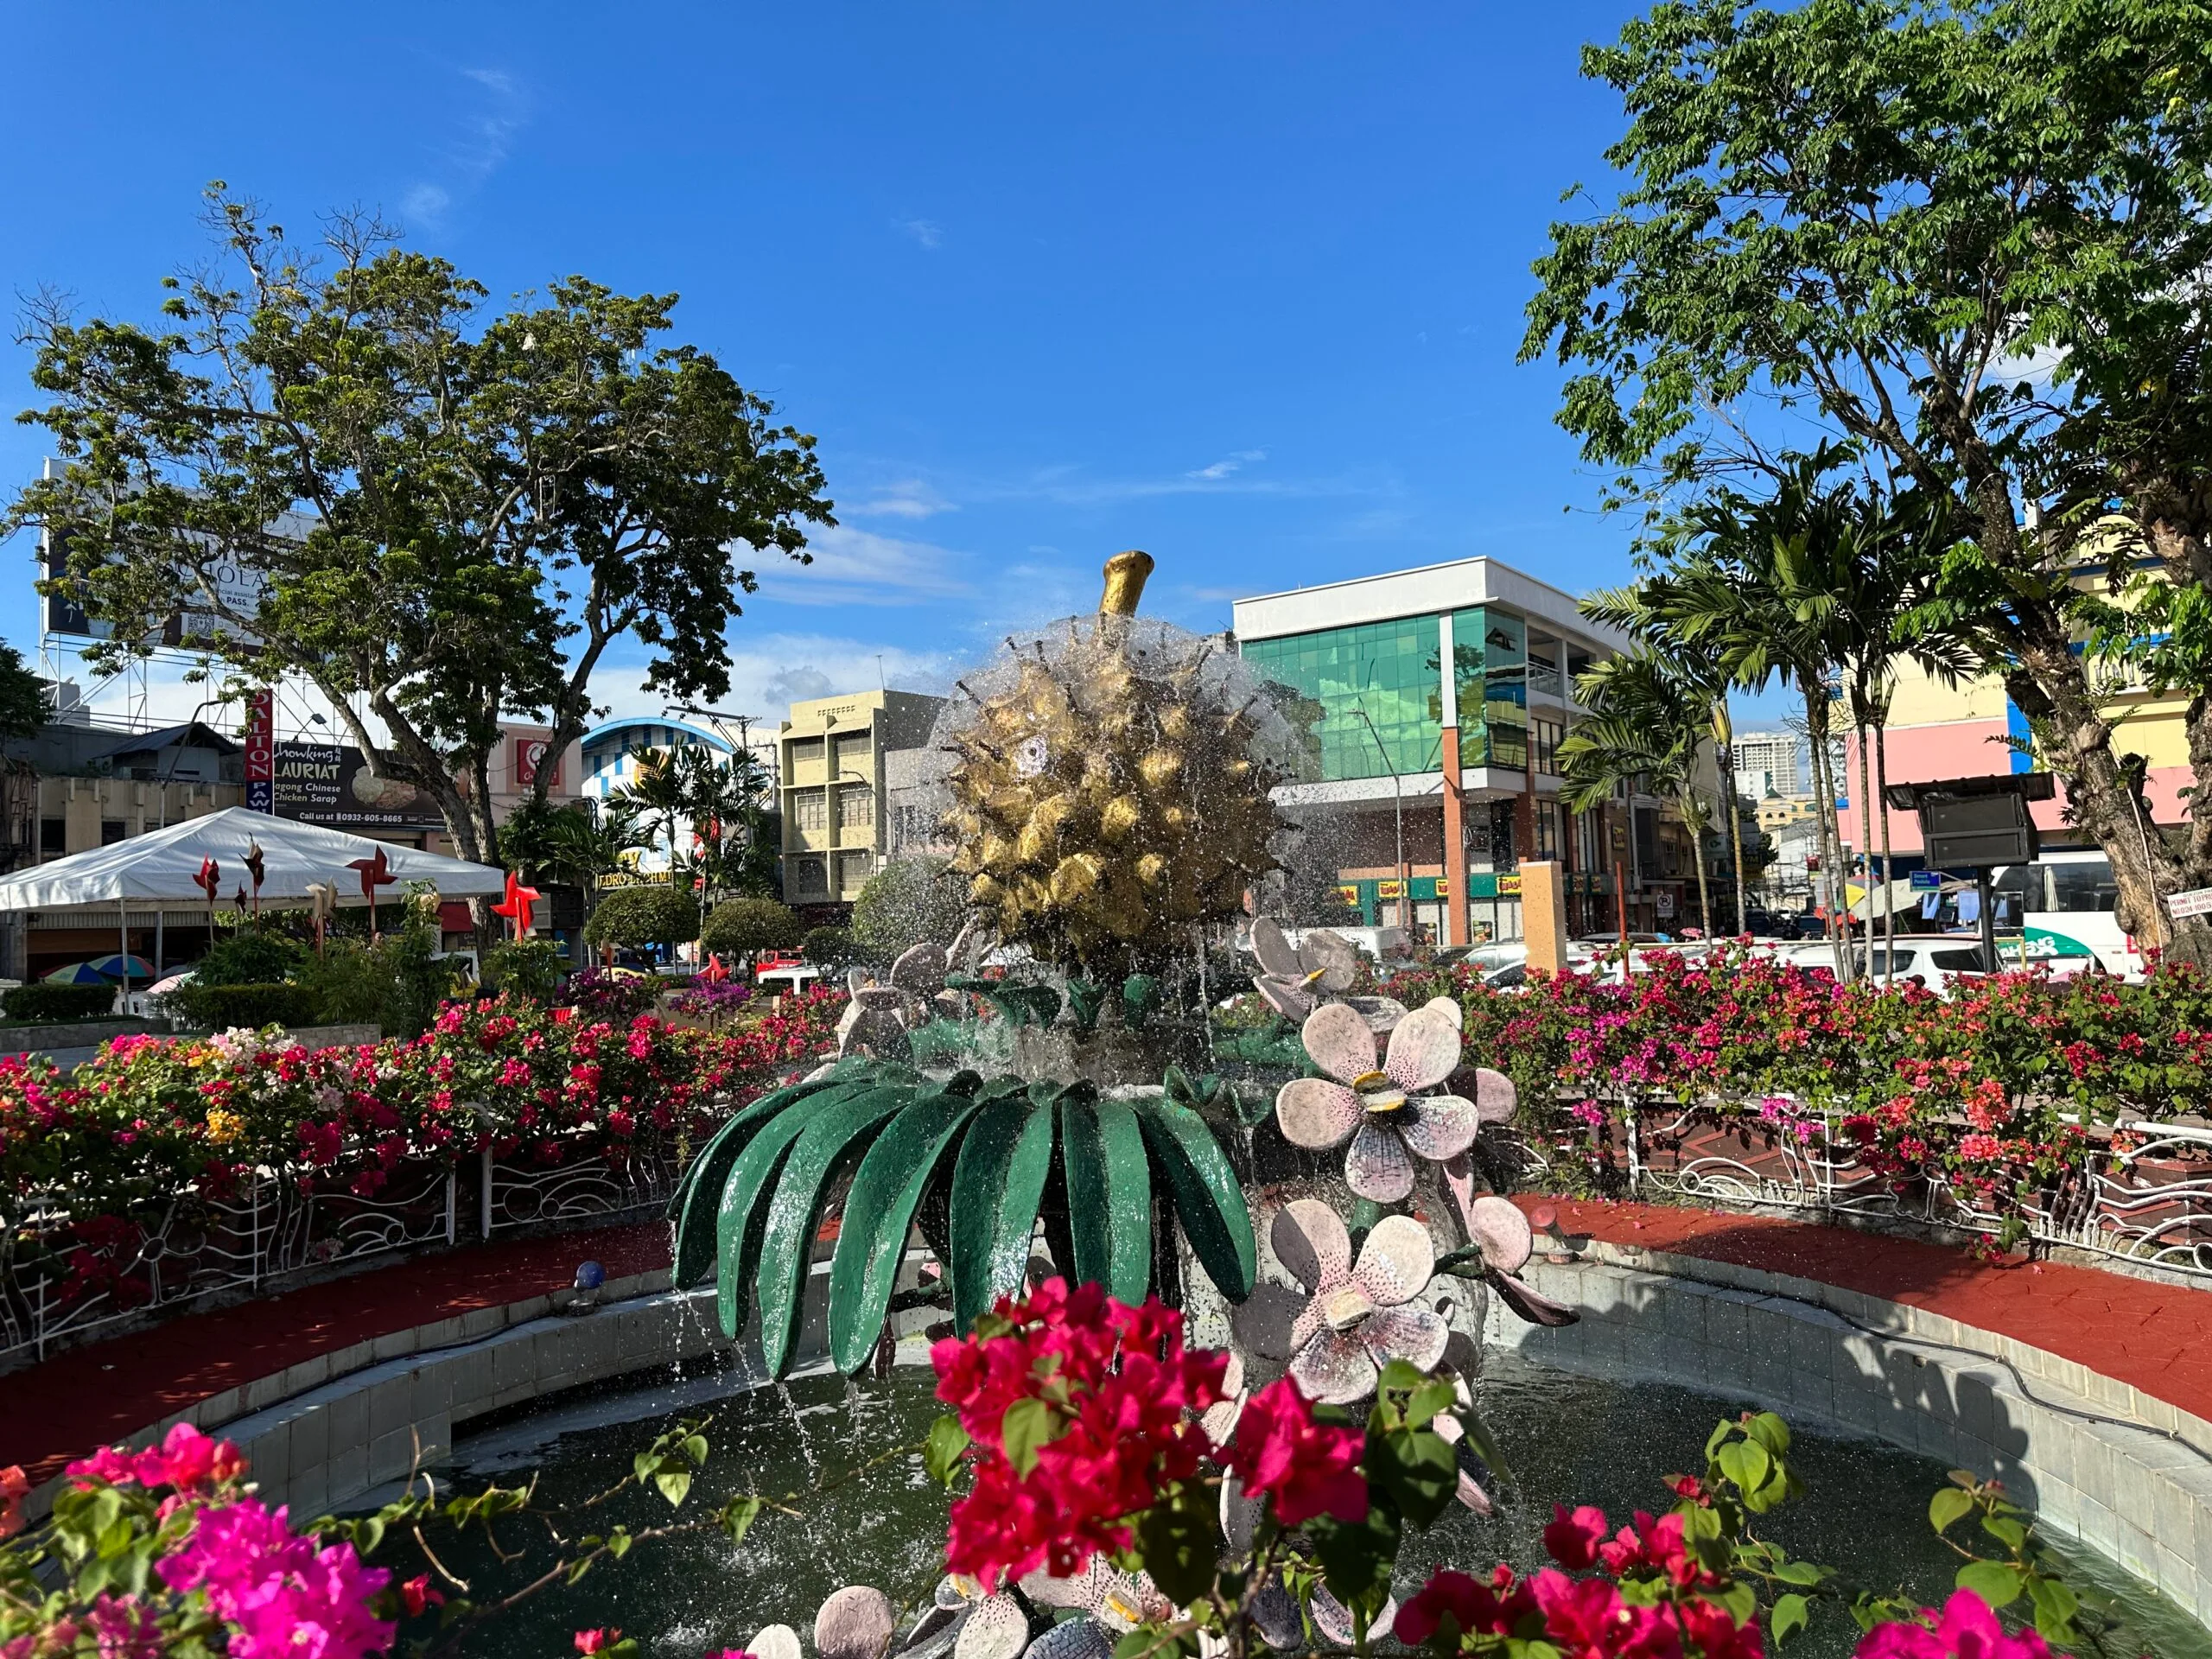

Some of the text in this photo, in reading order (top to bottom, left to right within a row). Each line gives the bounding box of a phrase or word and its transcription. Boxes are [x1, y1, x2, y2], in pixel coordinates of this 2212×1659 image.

[249, 692, 270, 777] DALTON
[274, 761, 340, 780] LAURIAT
[274, 783, 341, 793] agong Chinese
[274, 792, 337, 805] Chicken Sarap
[299, 812, 315, 821] Call
